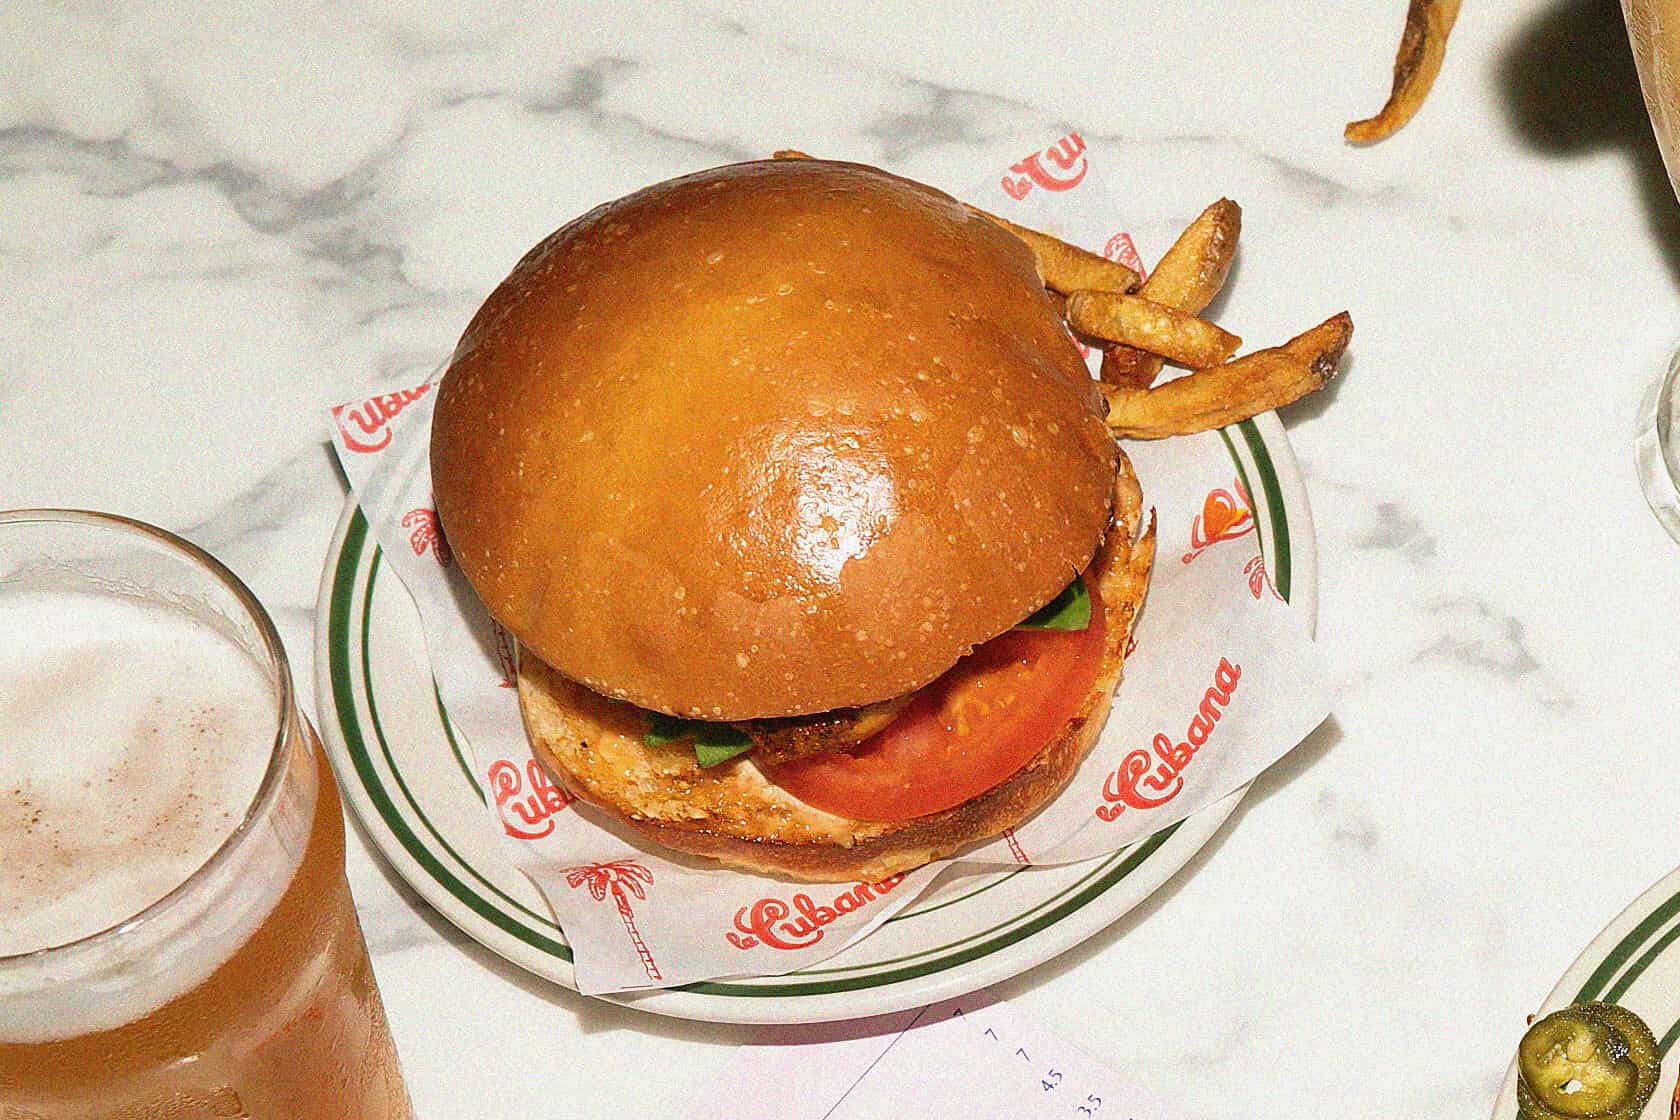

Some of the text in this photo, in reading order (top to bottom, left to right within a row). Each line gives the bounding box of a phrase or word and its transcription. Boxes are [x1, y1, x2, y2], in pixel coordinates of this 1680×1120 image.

[1096, 656, 1242, 822] la Cubana
[725, 931, 760, 950] la
[983, 1026, 998, 1041] 7
[1014, 1047, 1030, 1061] 7
[1040, 1068, 1062, 1092] 4.5
[1076, 1093, 1102, 1118] 3.5
